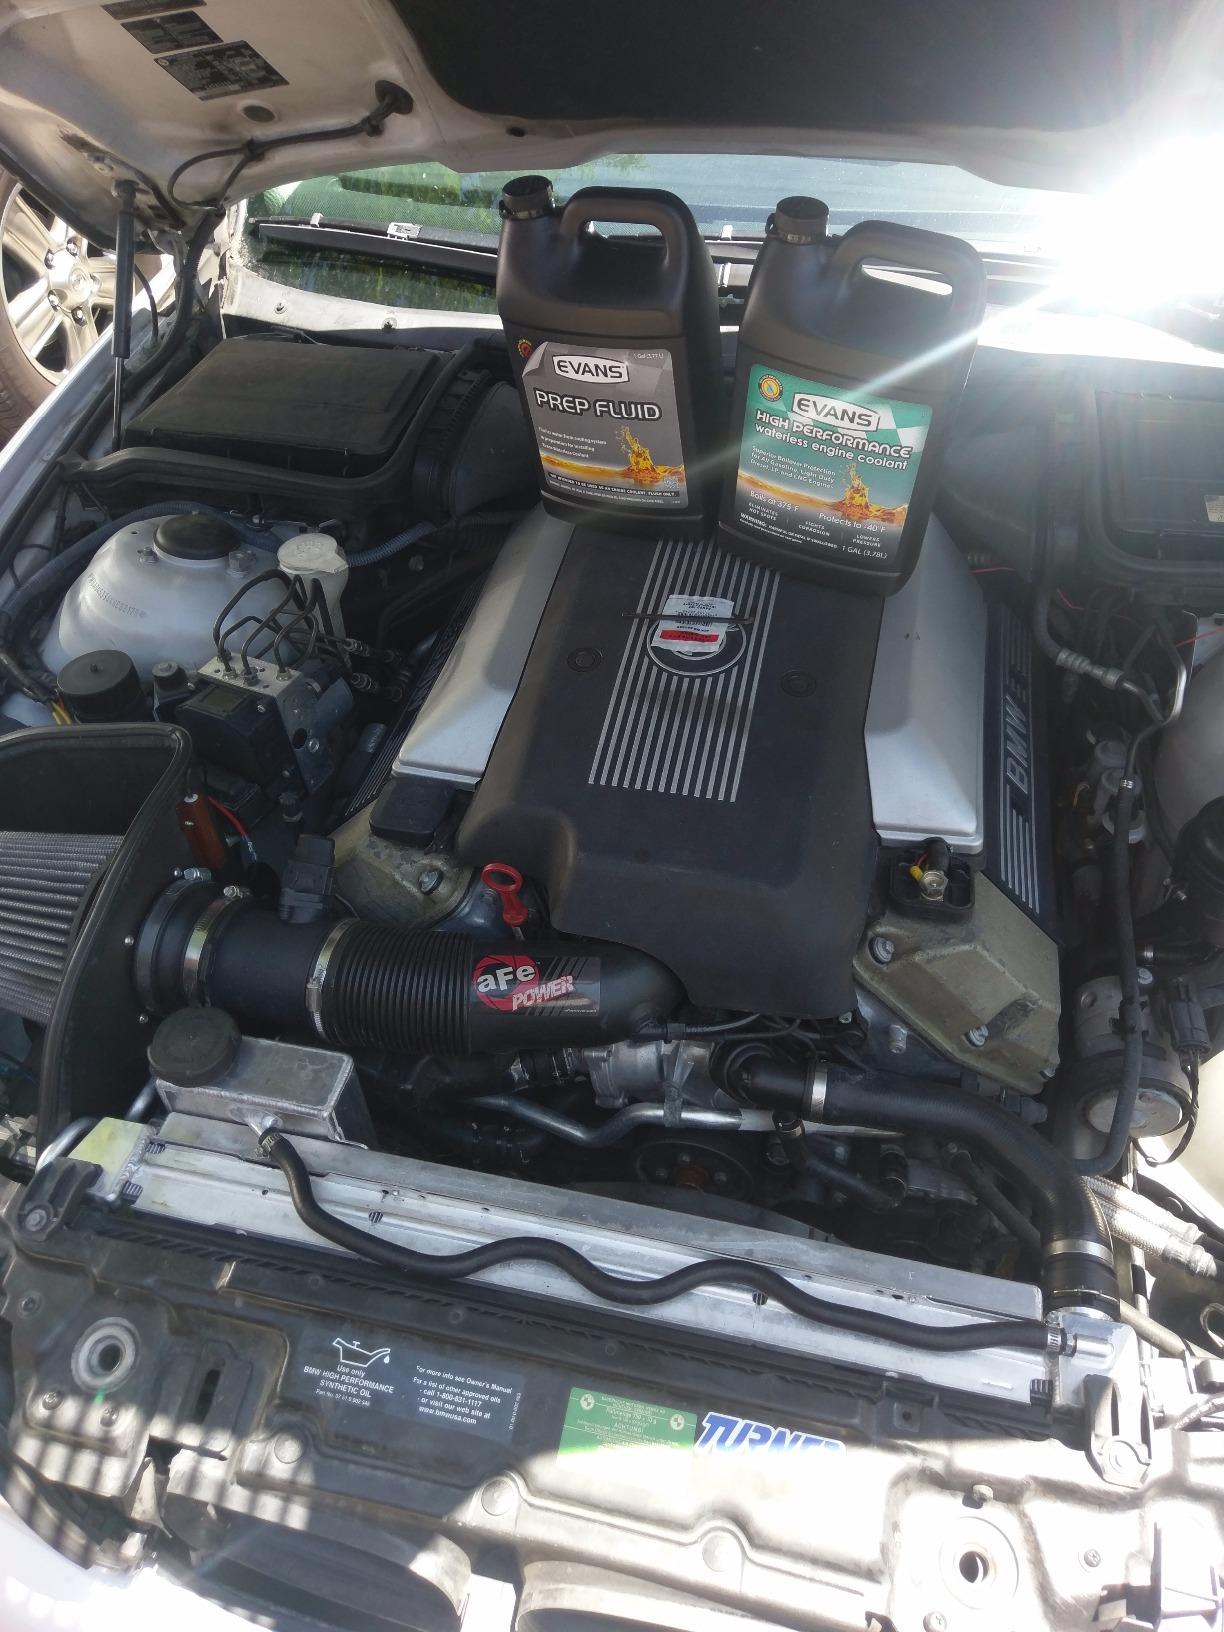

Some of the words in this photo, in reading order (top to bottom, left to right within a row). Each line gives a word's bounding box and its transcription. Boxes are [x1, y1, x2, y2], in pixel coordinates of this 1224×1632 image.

[556, 359, 623, 379] EVANS
[534, 389, 590, 415] PREP
[595, 400, 661, 420] FLUID
[796, 396, 873, 428] EVANS
[756, 409, 790, 430] HIGH
[793, 419, 914, 459] PERFORMANCE
[755, 422, 808, 448] waterless
[811, 442, 855, 461] engine
[857, 452, 908, 471] coolant
[752, 445, 777, 458] Superior
[777, 455, 802, 467] Boilover
[803, 463, 836, 476] Protection
[780, 469, 793, 478] and
[800, 468, 817, 478] Light
[818, 474, 835, 484] Duty
[750, 490, 767, 502] Boils
[768, 497, 776, 506] at
[748, 502, 778, 516] ELIMINATES
[760, 512, 777, 521] SPOTS
[798, 524, 830, 537] CORROSION
[818, 512, 852, 527] Protects
[853, 520, 862, 529] to
[852, 538, 881, 548] PRESSURE
[856, 534, 880, 542] LOWERS
[847, 546, 862, 555] GAL
[1005, 694, 1028, 794] BMW
[477, 965, 536, 993] aFe
[511, 975, 575, 1012] POWER
[303, 1365, 322, 1376] BMW
[322, 1370, 340, 1381] HIGH
[340, 1374, 395, 1394] PERFORMANCE
[337, 1364, 350, 1373] Use
[350, 1368, 366, 1378] only
[416, 1365, 426, 1373] For
[426, 1369, 442, 1377] more
[442, 1371, 454, 1380] info
[454, 1375, 466, 1383] see
[466, 1377, 490, 1389] Owner's
[490, 1383, 513, 1394] Manual
[320, 1379, 359, 1395] SYNTHETIC
[359, 1388, 373, 1398] OIL
[413, 1376, 423, 1384] For
[428, 1380, 438, 1388] list
[438, 1382, 446, 1390] of
[445, 1385, 461, 1394] other
[461, 1389, 490, 1401] approved
[490, 1396, 501, 1404] oils
[423, 1388, 436, 1396] call
[418, 1405, 477, 1425] www.bmwusa.com
[429, 1398, 443, 1408] visit
[443, 1402, 456, 1411] our
[456, 1404, 470, 1415] web
[470, 1408, 483, 1418] site
[483, 1411, 491, 1420] at
[699, 1413, 842, 1451] TURN
